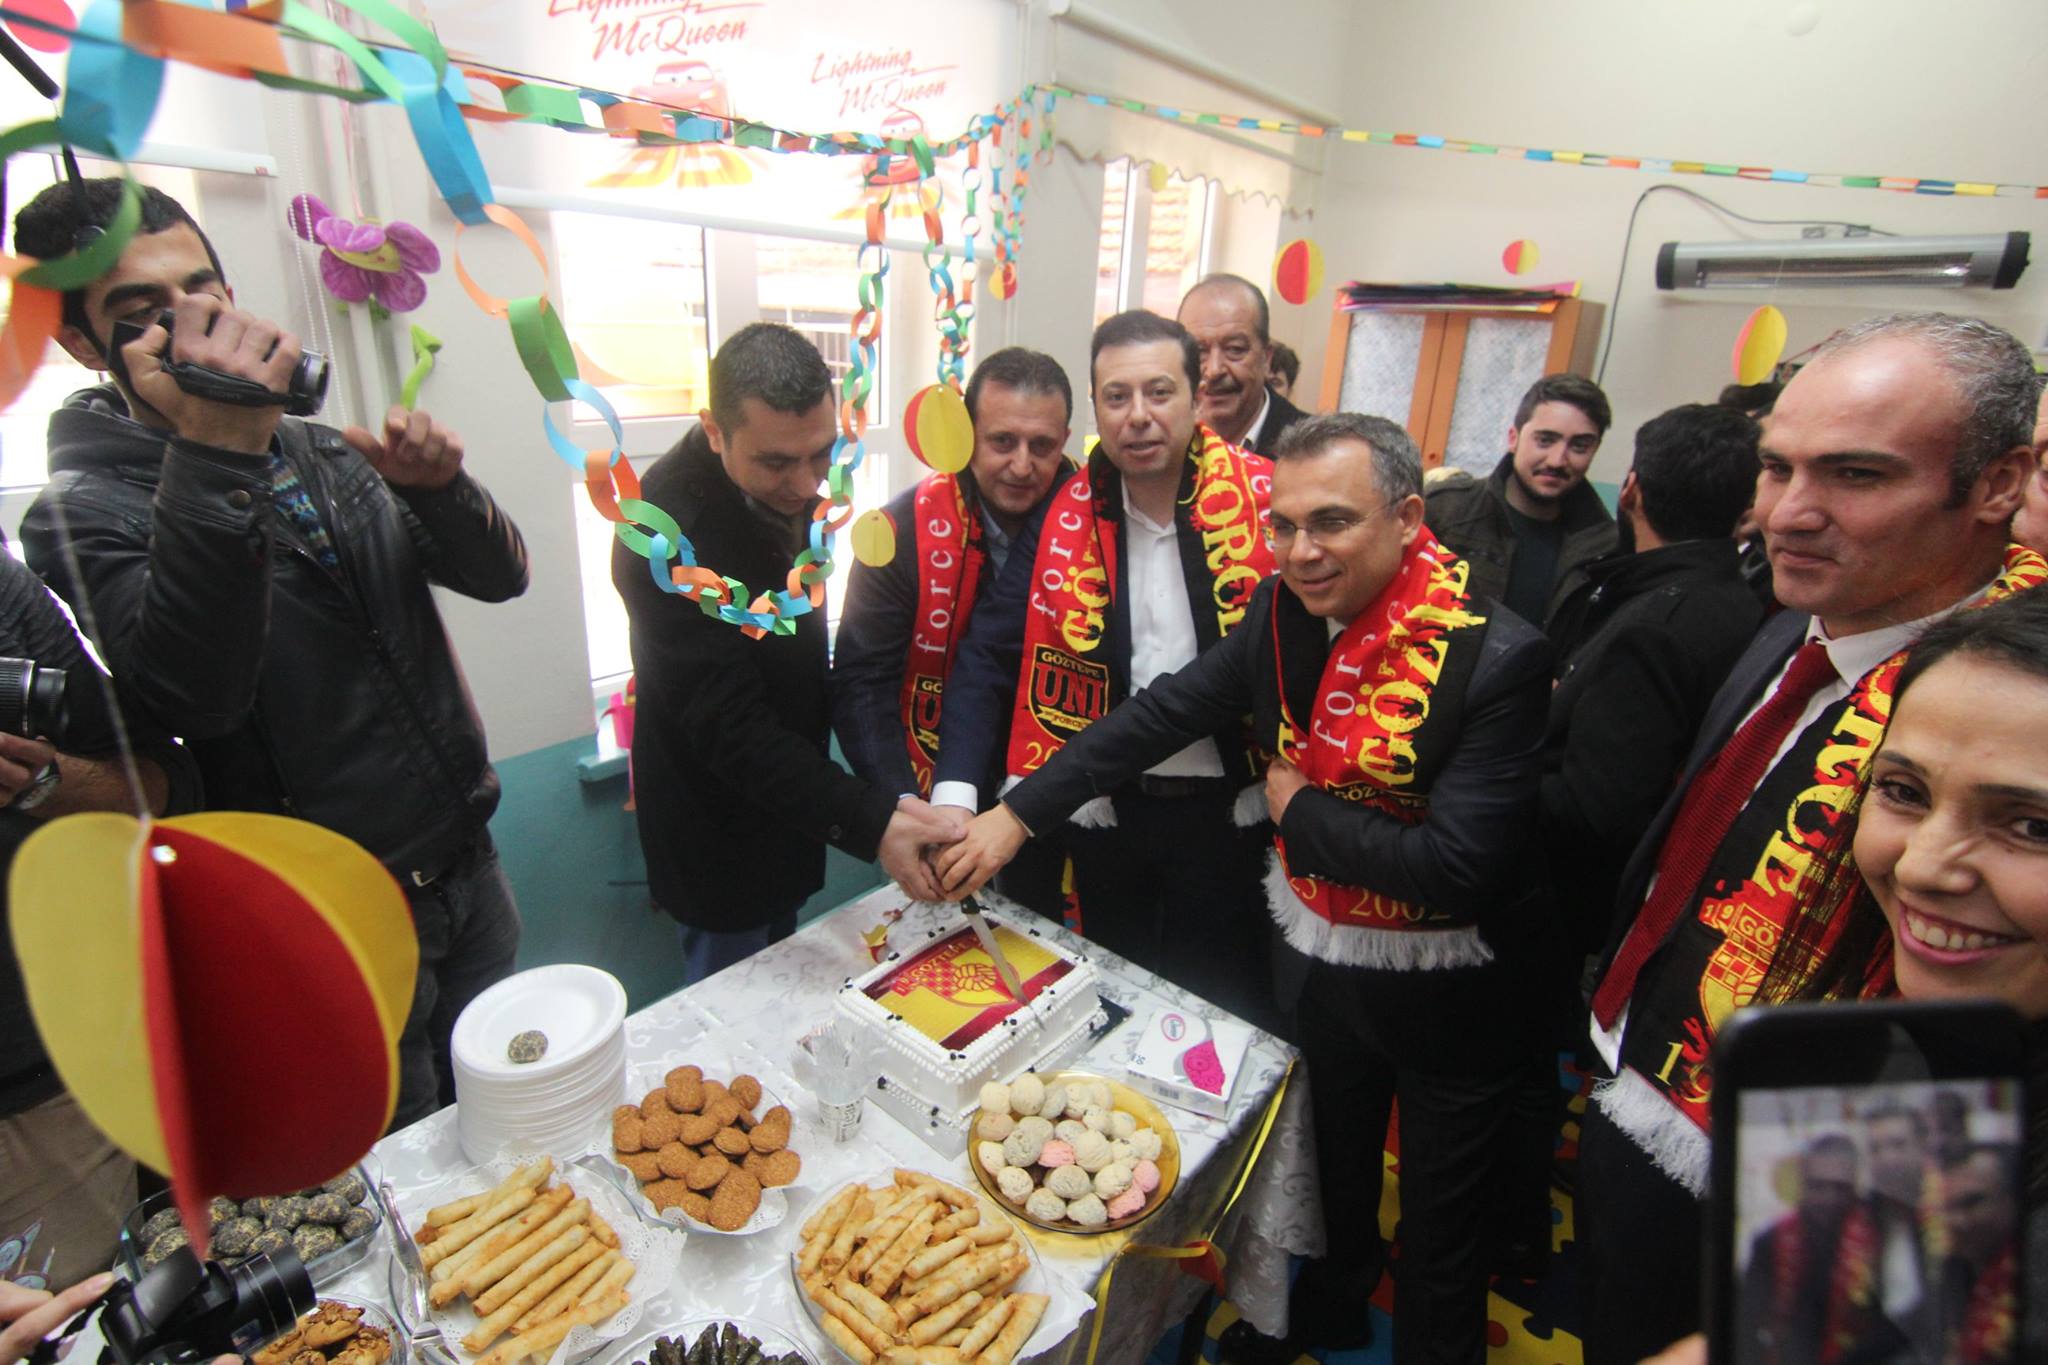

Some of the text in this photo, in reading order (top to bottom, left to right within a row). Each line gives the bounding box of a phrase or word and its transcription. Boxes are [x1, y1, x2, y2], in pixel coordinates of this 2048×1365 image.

[593, 15, 746, 61] McQueen
[811, 47, 930, 87] Lightning
[838, 79, 947, 117] McQueen
[1031, 479, 1092, 620] force
[1035, 662, 1104, 721] UNI
